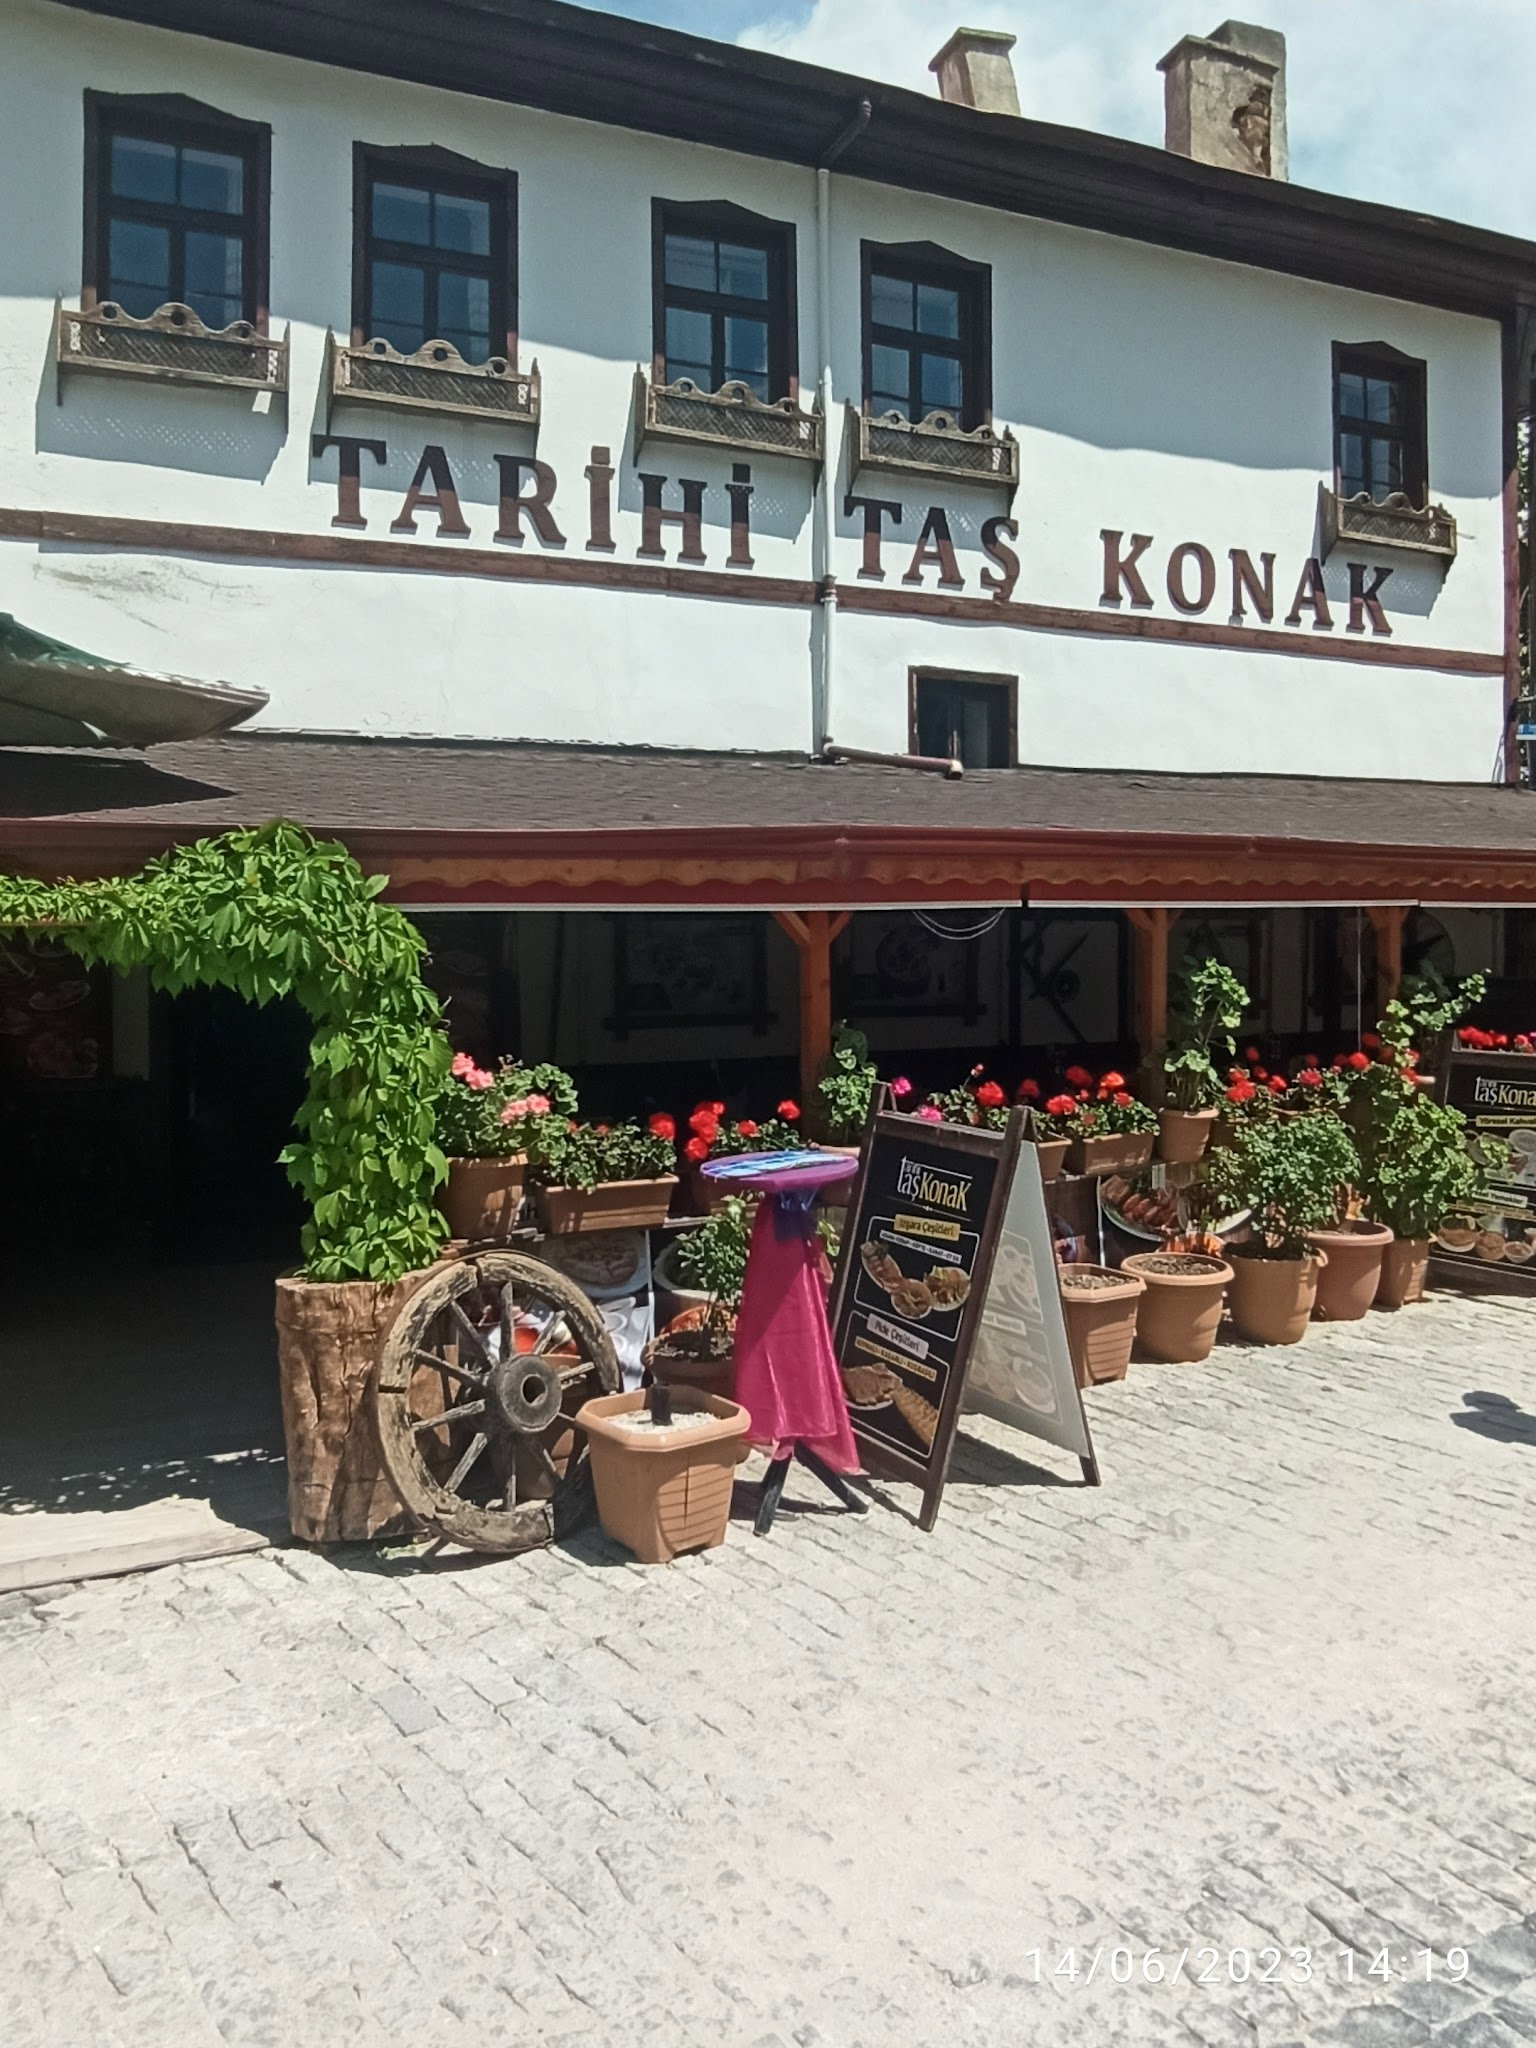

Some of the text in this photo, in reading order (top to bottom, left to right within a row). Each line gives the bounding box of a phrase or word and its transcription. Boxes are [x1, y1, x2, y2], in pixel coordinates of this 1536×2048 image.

[312, 434, 1394, 637] TARİHİ TAŞ KONAK
